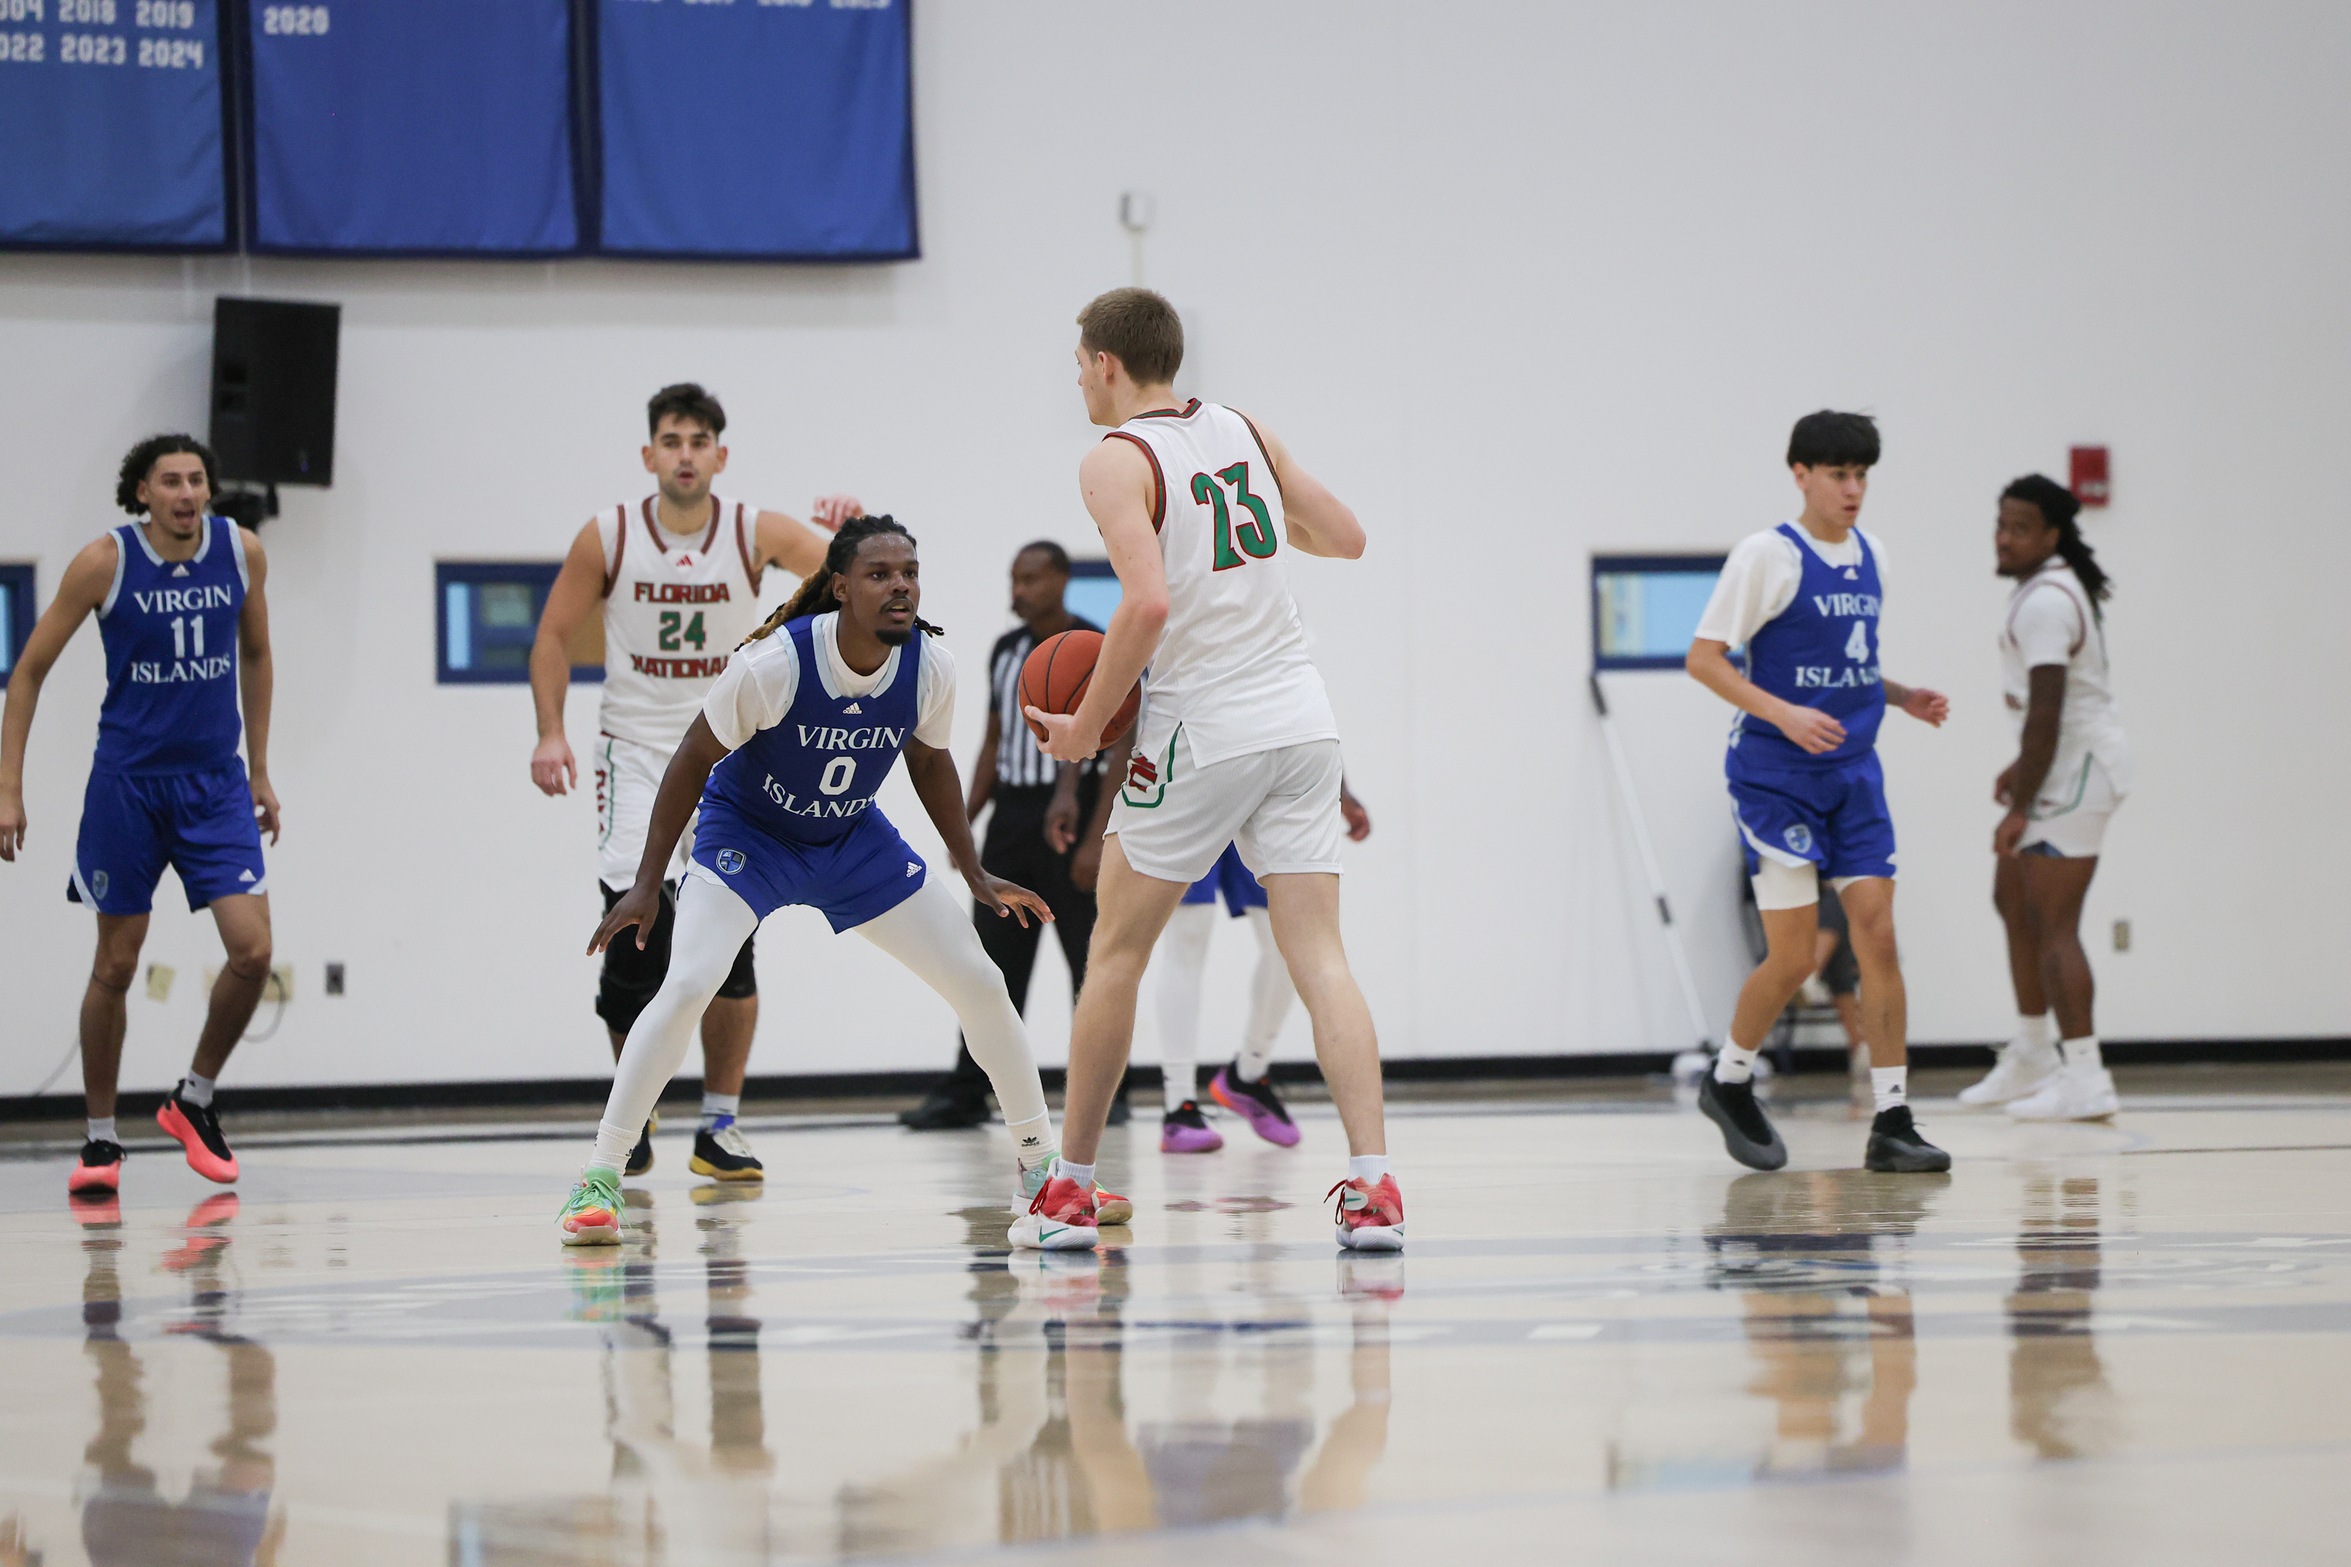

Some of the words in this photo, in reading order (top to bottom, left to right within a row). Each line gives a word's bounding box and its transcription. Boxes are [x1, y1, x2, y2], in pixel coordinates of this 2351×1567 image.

[264, 5, 329, 35] 2020
[61, 33, 127, 65] 2023
[138, 38, 204, 69] 2024
[1190, 461, 1277, 572] 23
[133, 584, 232, 614] VIRGIN
[634, 582, 730, 604] FLORIDA
[170, 614, 205, 659] 11
[659, 611, 706, 651] 24
[1844, 620, 1869, 664] 4
[131, 652, 231, 684] ISLANDS
[797, 724, 905, 751] VIRGIN
[818, 756, 857, 796] 0
